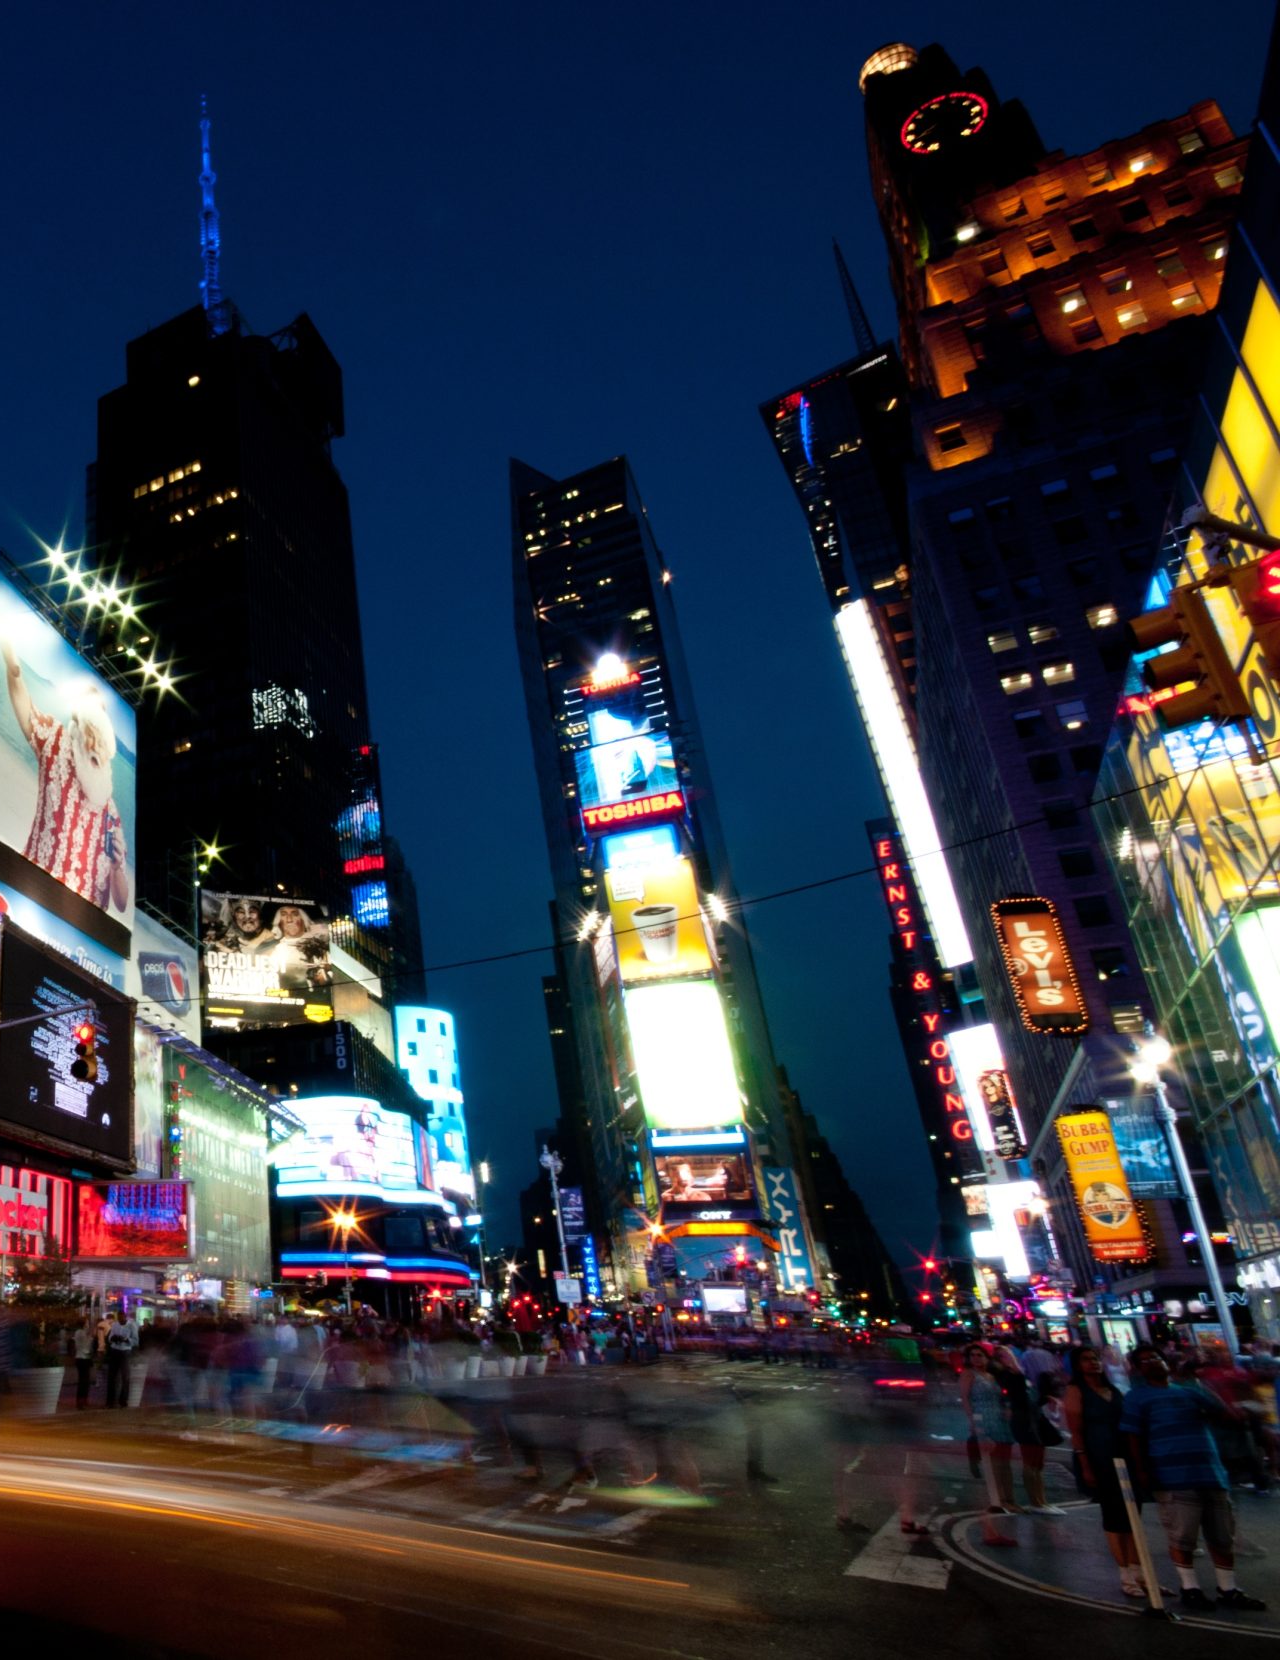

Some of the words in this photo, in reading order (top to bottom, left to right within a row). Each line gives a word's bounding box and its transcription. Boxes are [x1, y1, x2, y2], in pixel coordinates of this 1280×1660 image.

[584, 792, 683, 825] TOSHIBA
[144, 961, 166, 976] pepsi
[878, 839, 915, 949] ERNST
[923, 1014, 973, 1141] YOUNG
[1060, 1122, 1110, 1139] BUBBA
[1069, 1139, 1110, 1156] GUMP
